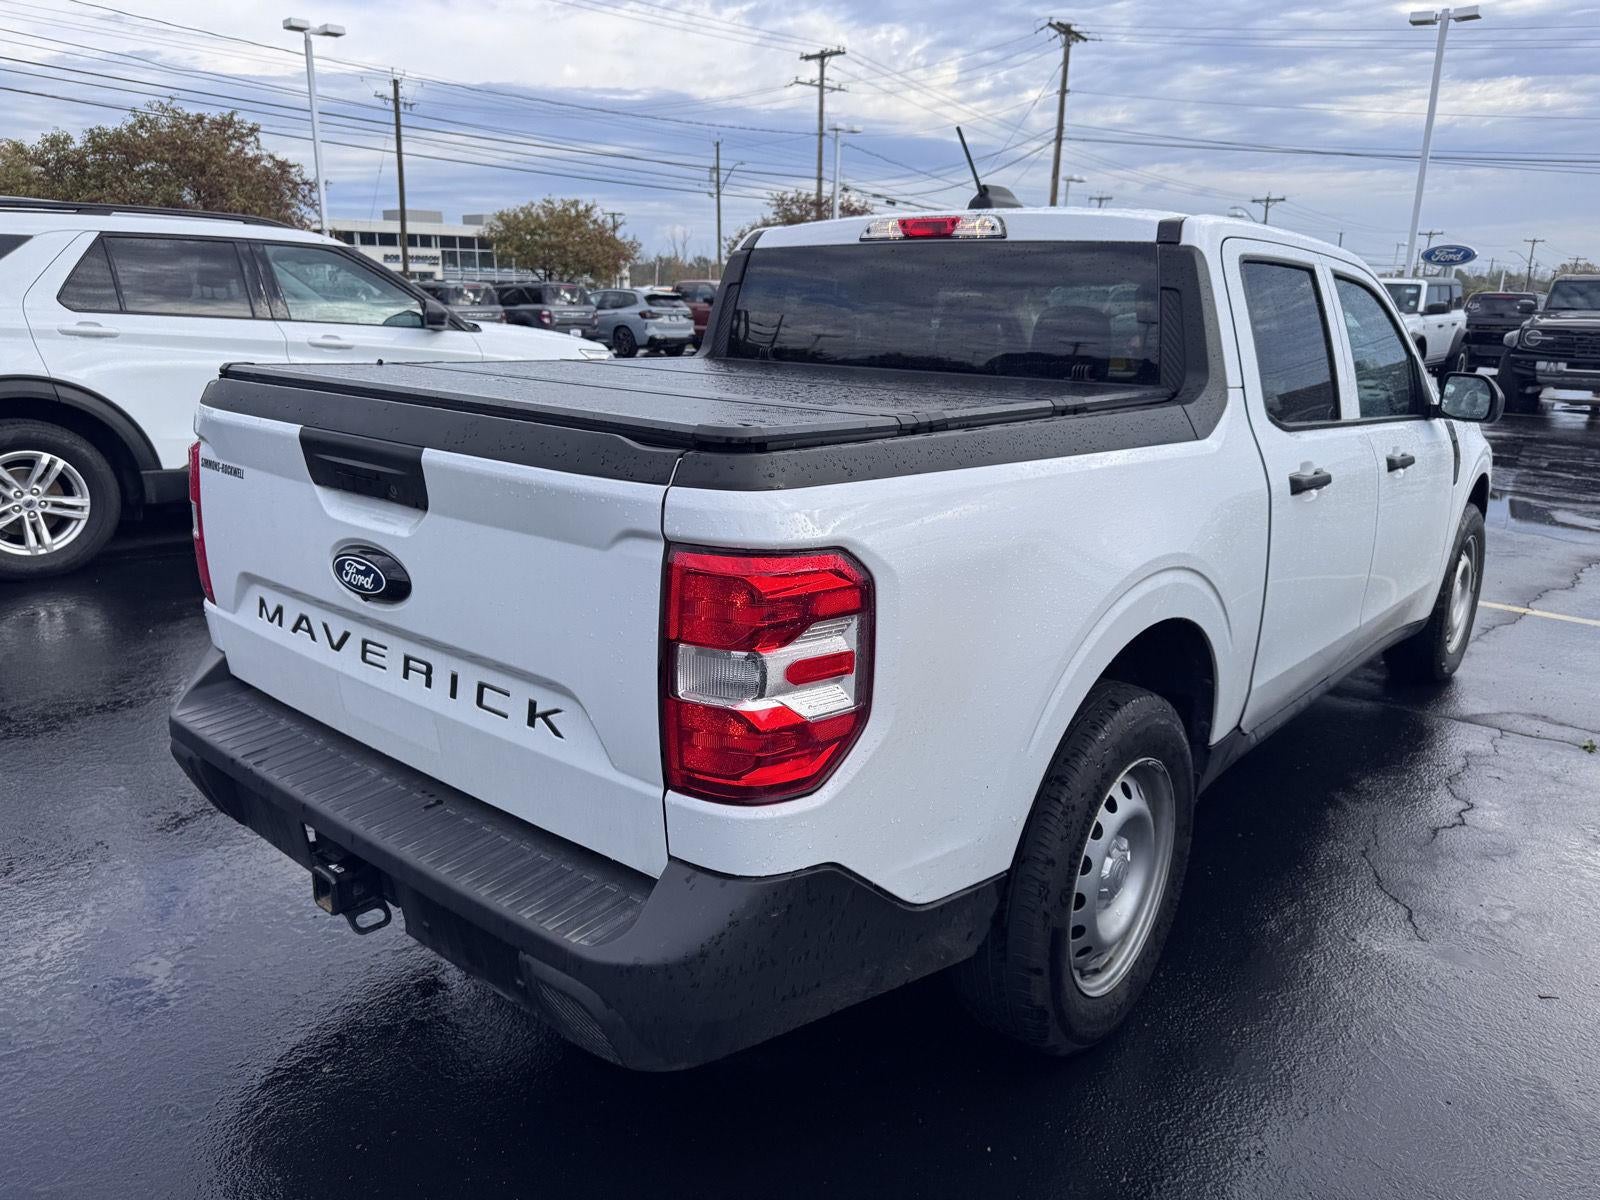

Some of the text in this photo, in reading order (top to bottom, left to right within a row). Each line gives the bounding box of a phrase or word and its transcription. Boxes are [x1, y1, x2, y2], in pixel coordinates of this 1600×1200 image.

[1431, 248, 1465, 261] Ford
[201, 457, 244, 479] SIMMONS-ROCKWELL
[342, 560, 374, 590] Ford
[258, 596, 566, 740] MAVERICK
